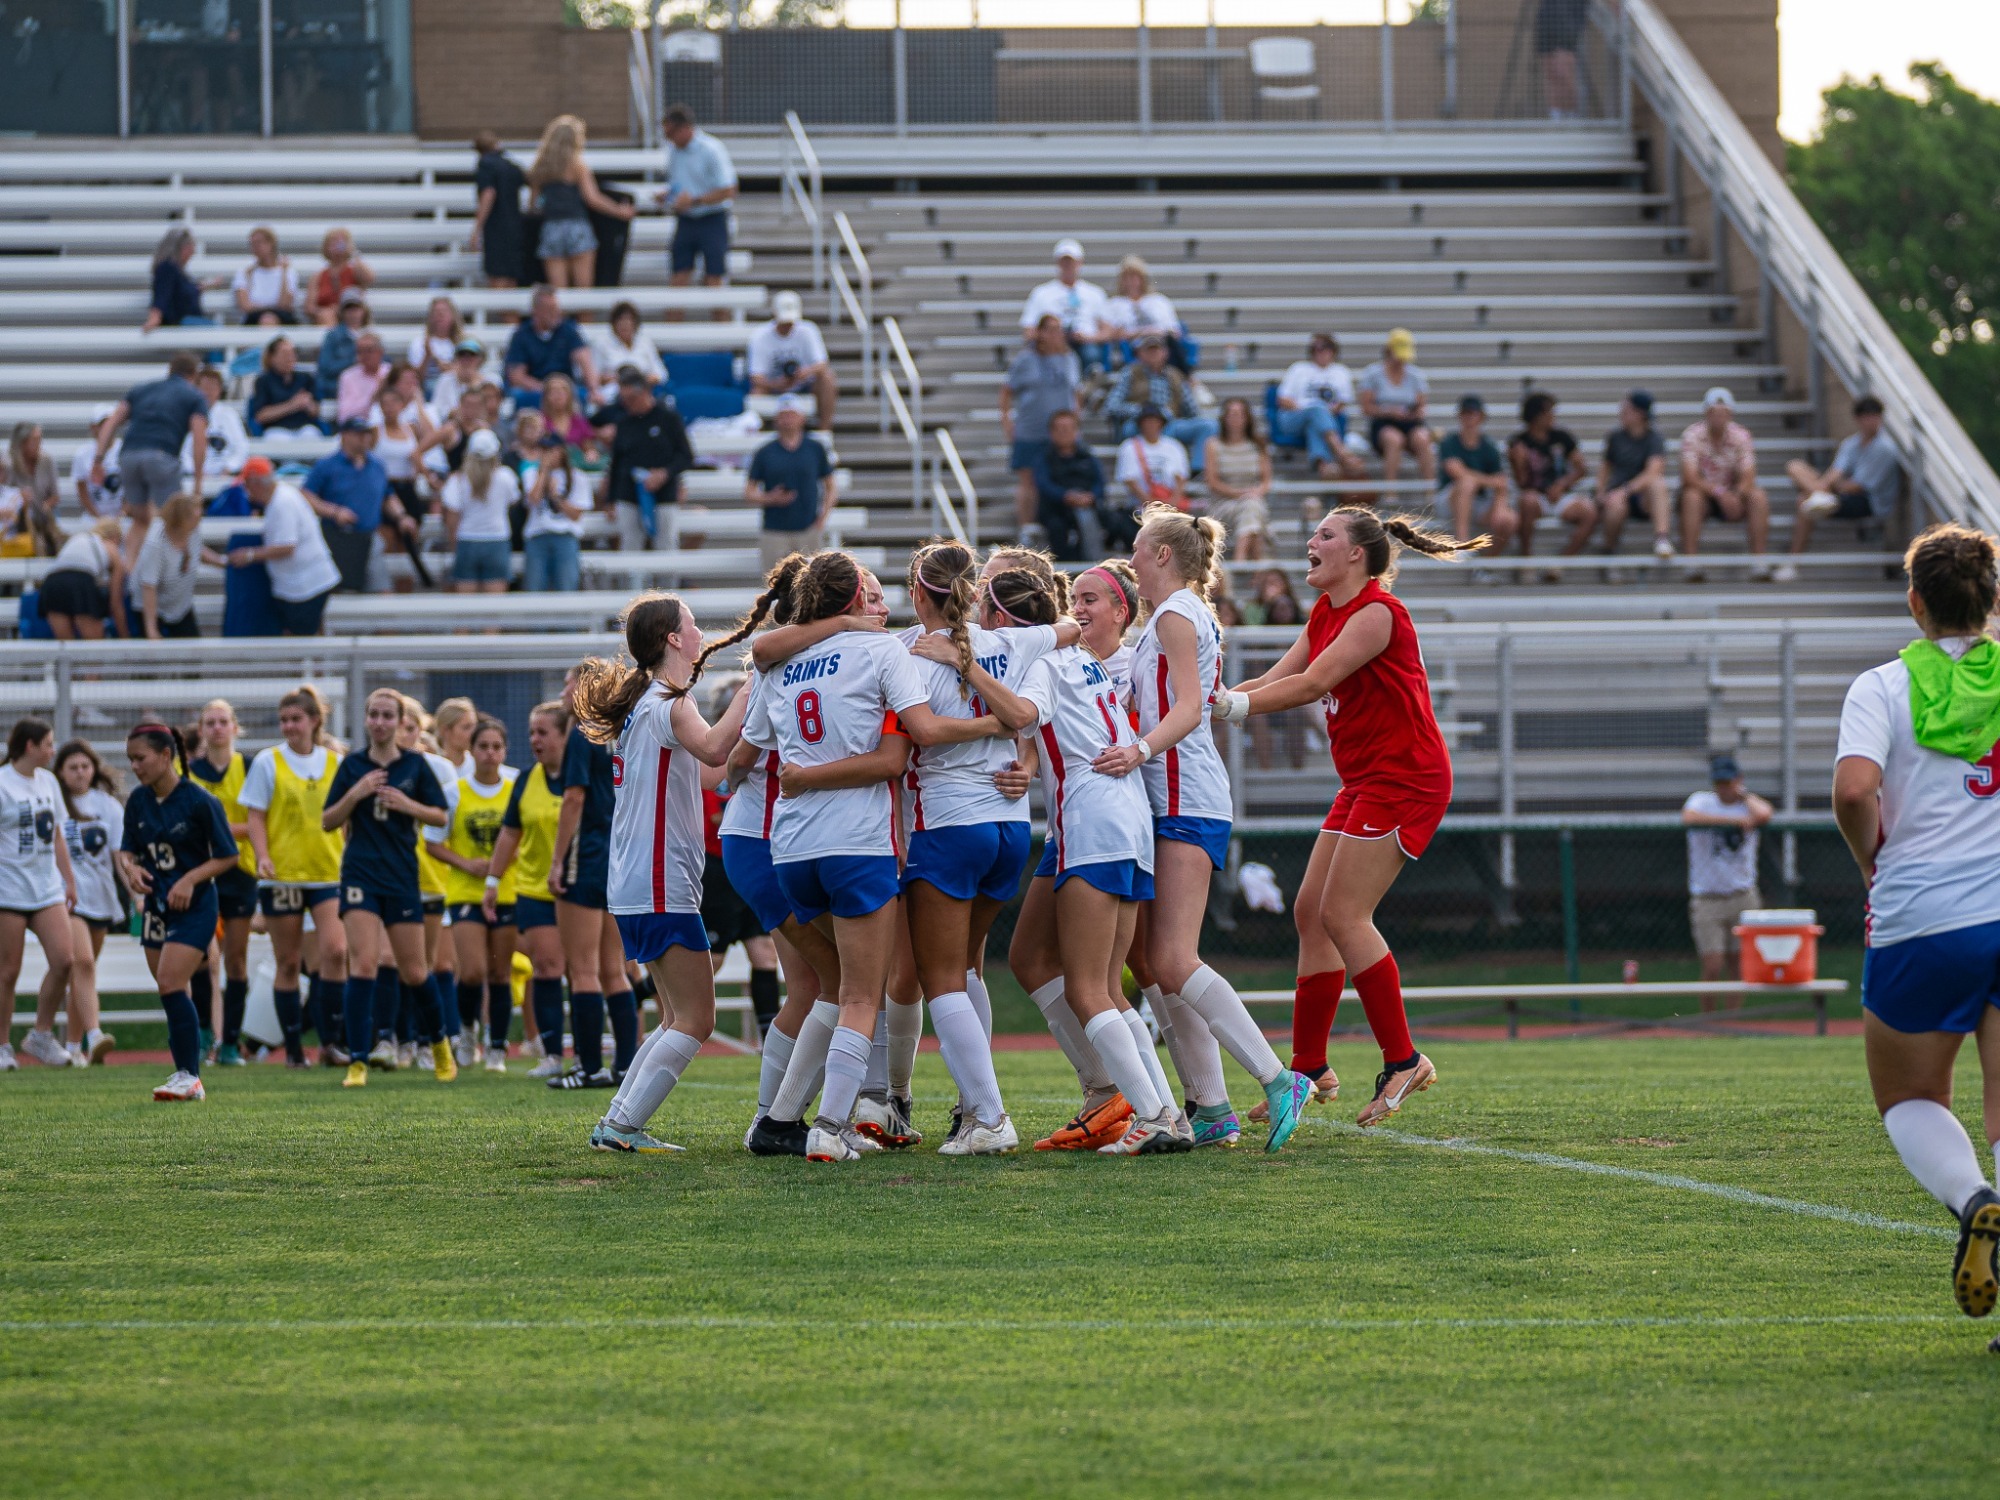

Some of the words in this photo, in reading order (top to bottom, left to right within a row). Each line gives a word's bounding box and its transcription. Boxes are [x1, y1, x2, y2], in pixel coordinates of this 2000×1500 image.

[783, 653, 841, 687] SAINTS
[795, 687, 826, 746] 8
[147, 842, 176, 871] 13
[273, 885, 304, 912] 20
[144, 911, 166, 941] 13
